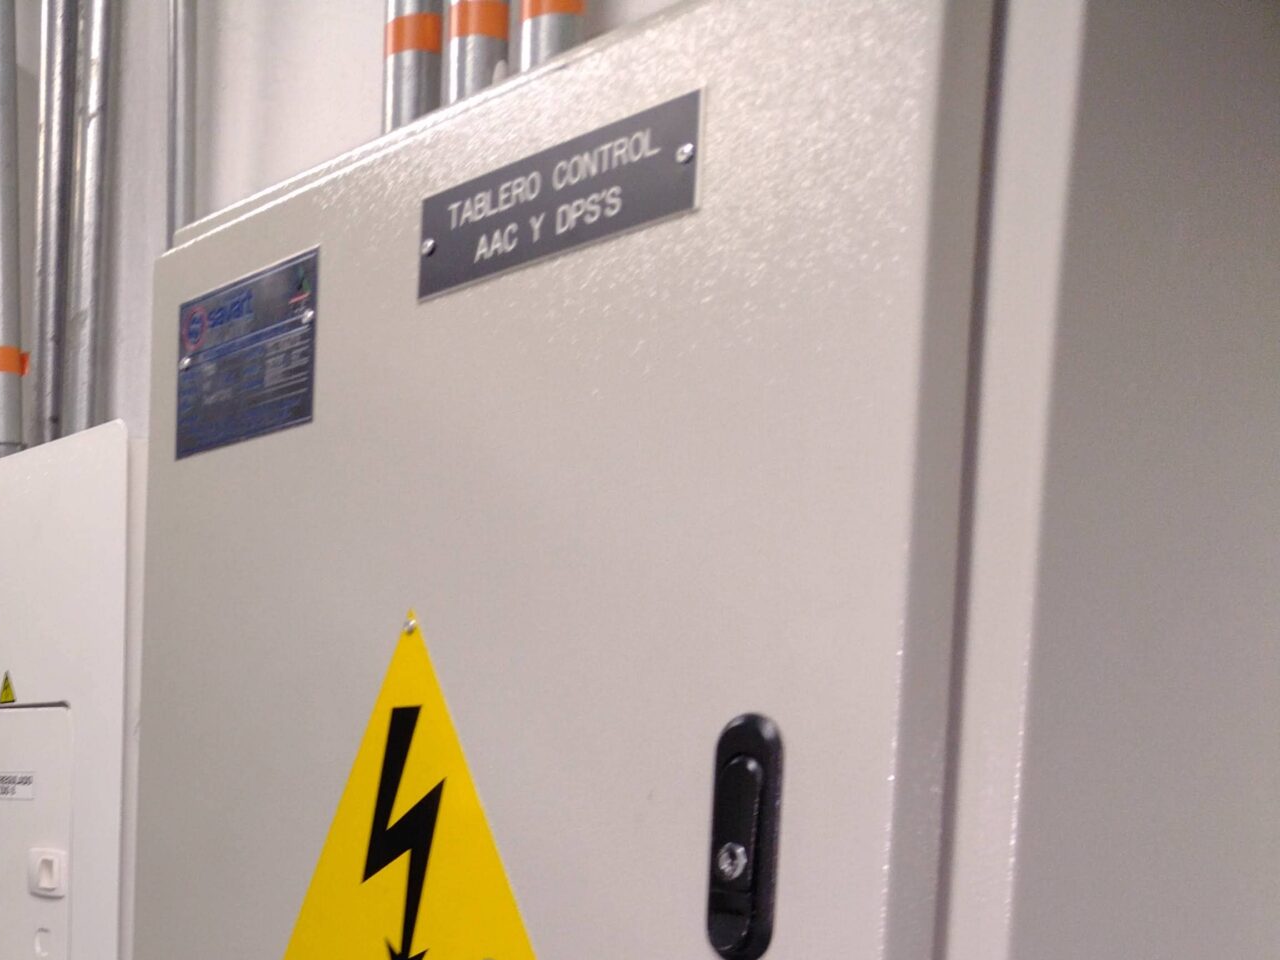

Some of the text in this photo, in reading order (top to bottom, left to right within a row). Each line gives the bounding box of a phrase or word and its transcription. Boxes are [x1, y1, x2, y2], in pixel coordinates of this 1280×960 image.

[447, 128, 661, 229] TABLERO CONTROL
[474, 221, 518, 263] AAC
[529, 212, 547, 244] Y
